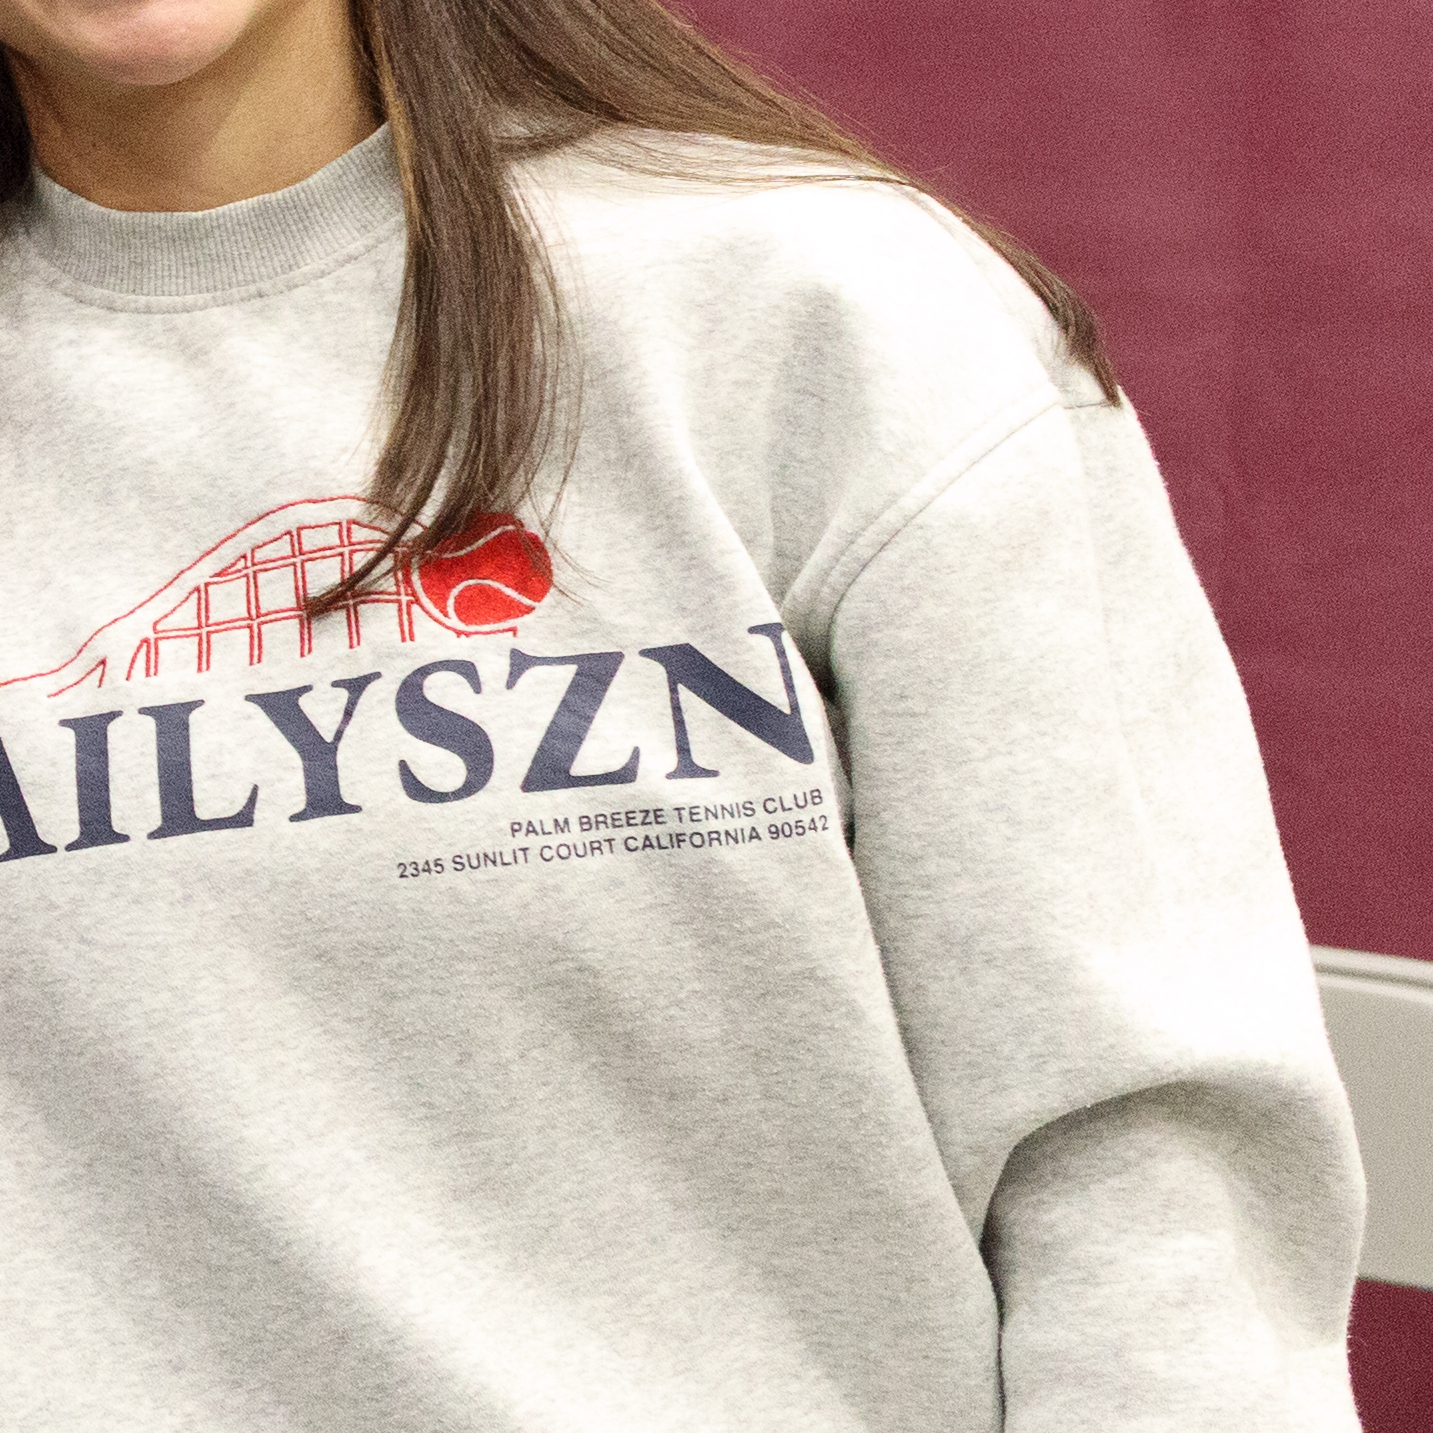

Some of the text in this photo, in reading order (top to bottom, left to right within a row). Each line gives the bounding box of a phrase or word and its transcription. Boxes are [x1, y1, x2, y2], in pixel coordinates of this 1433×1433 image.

[510, 788, 824, 838] PALM BREEZE TENNIS CLUB
[396, 814, 830, 879] 2345 SUNLIT COURT CALIFORNIA 90542
